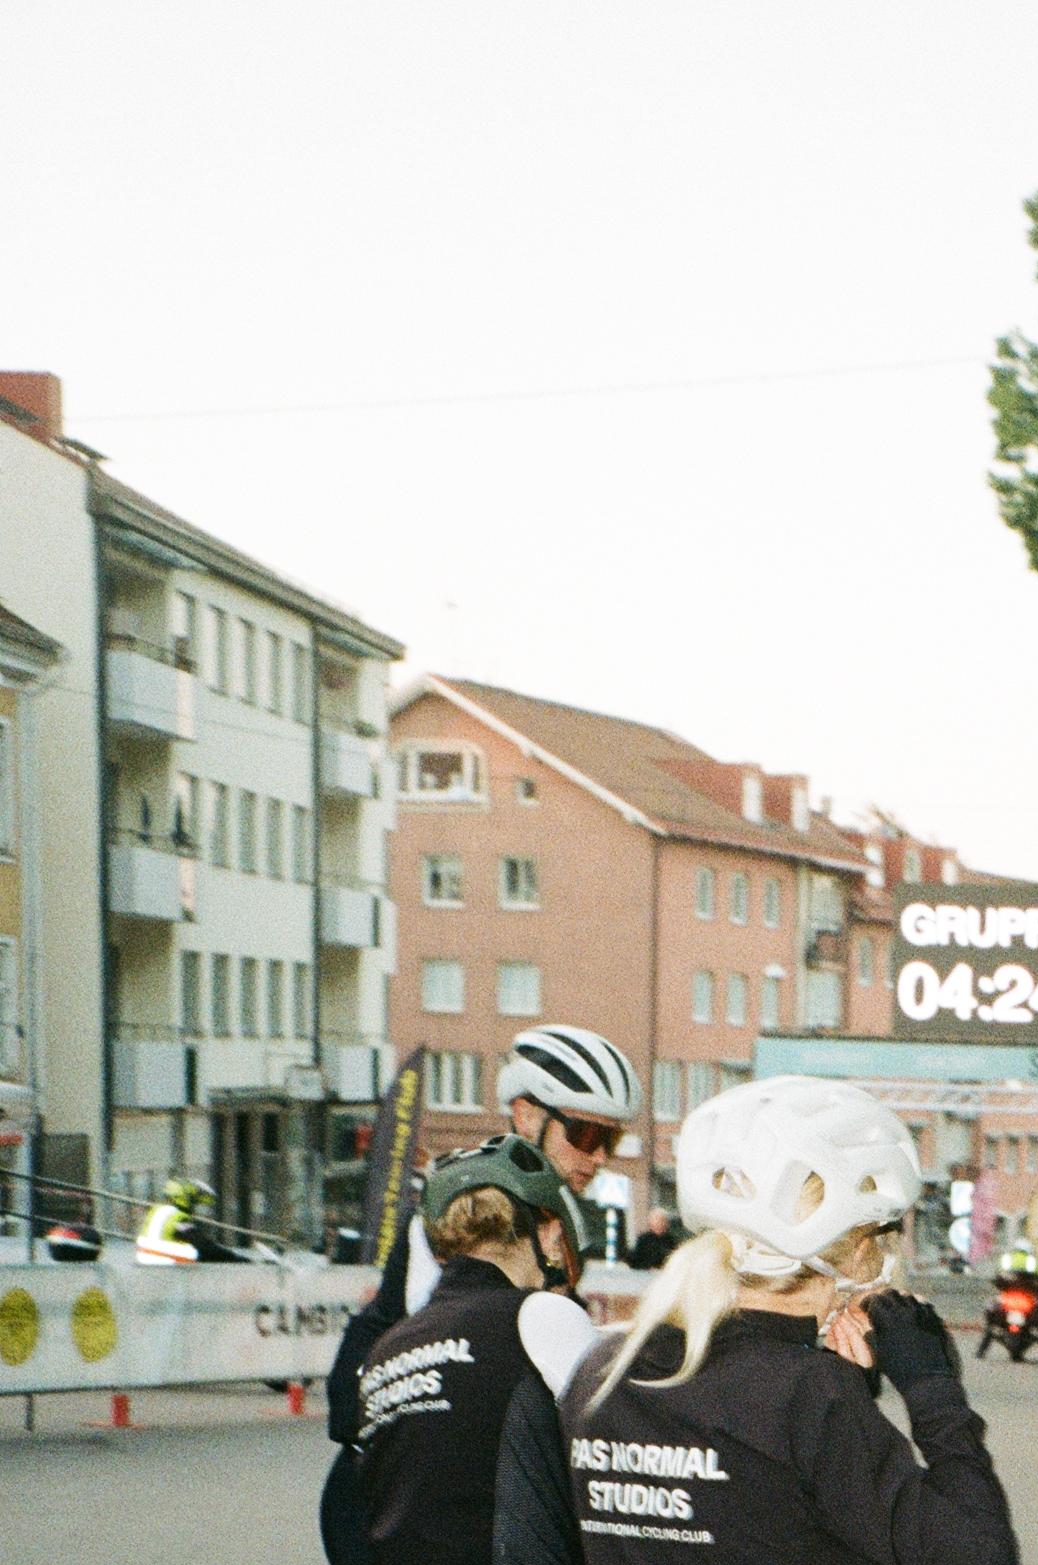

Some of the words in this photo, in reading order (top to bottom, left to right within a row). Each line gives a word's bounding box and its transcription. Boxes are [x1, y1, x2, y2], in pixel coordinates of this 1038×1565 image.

[609, 1441, 730, 1481] NORMAL
[588, 1480, 694, 1520] STUDIOS
[680, 1529, 716, 1545] CLUB
